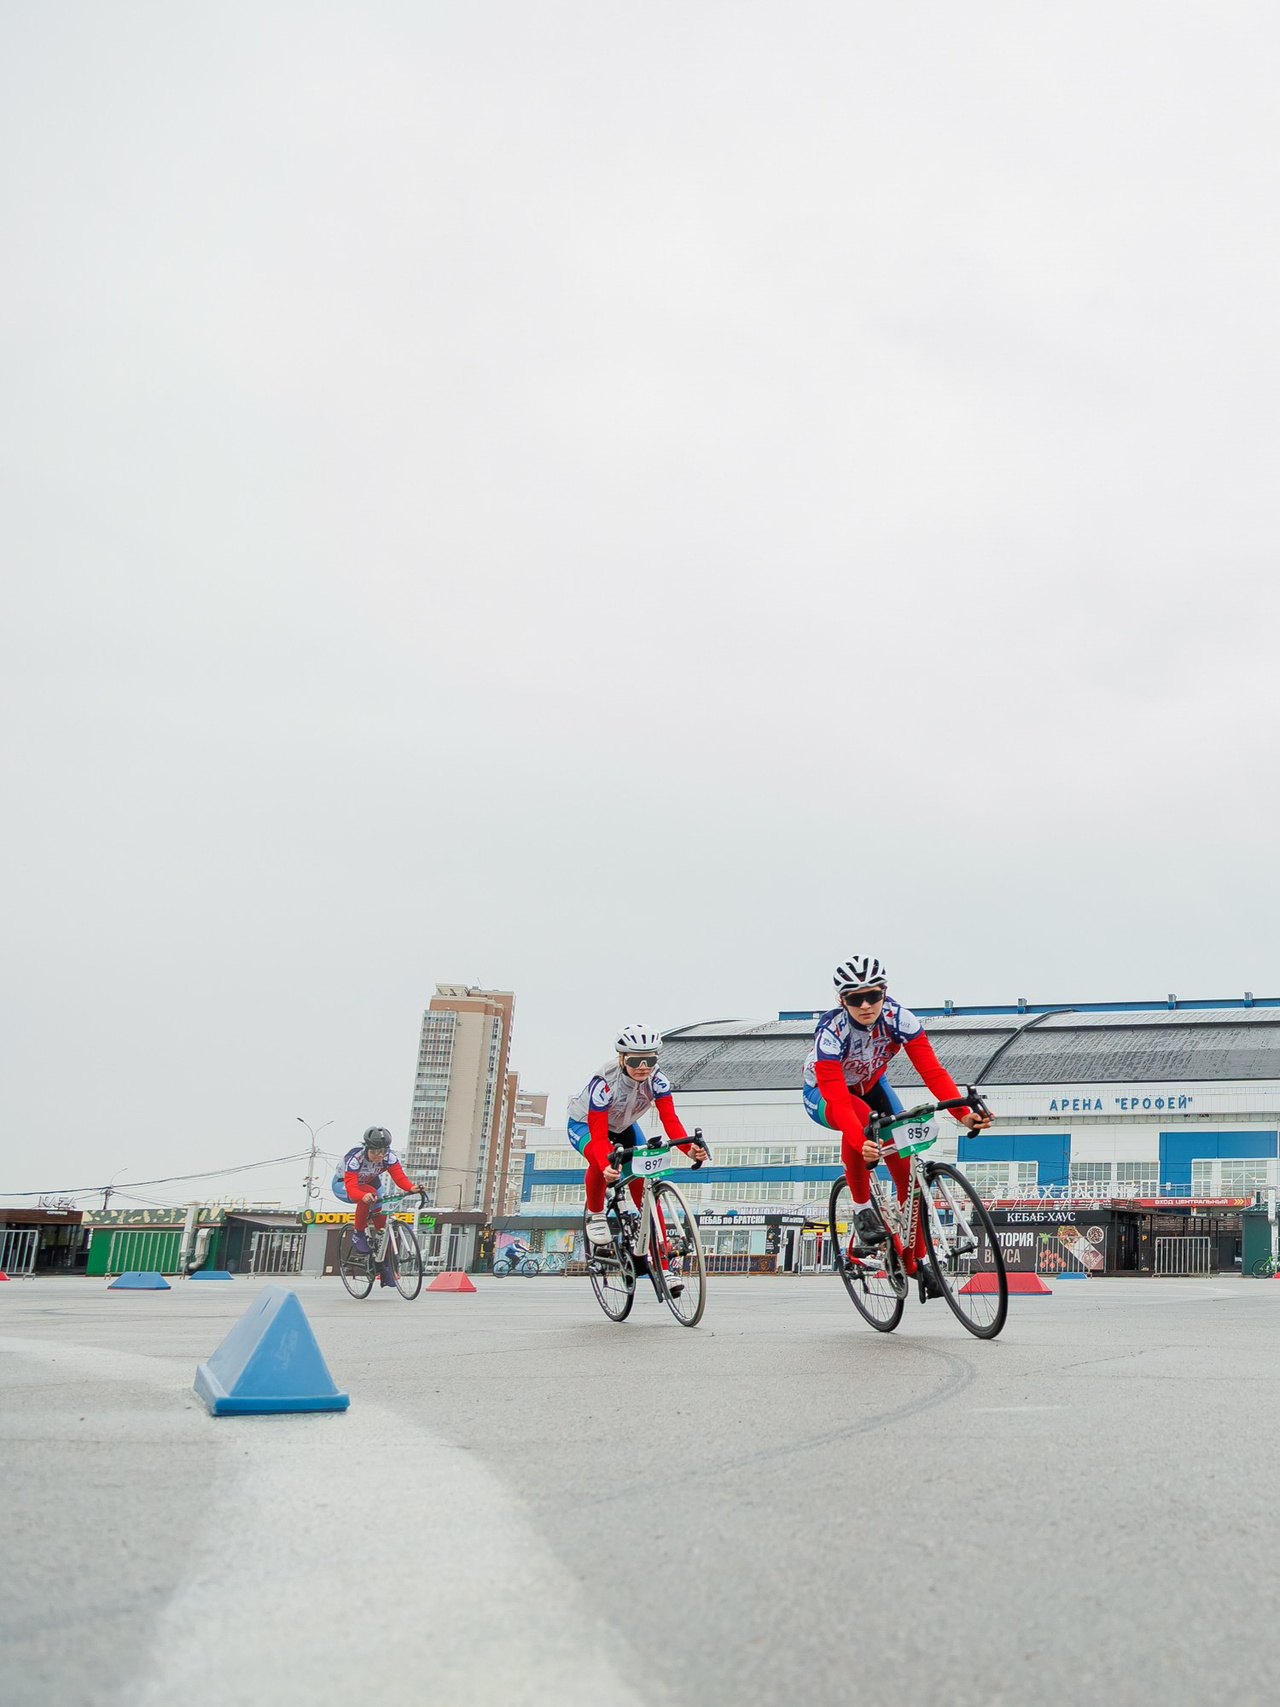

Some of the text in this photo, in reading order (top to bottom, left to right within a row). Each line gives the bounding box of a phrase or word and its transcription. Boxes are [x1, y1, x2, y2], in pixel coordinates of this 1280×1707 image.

[1049, 1095, 1193, 1111] АРЕНА "ЕРОФЕЙ"
[907, 1126, 931, 1140] 859
[644, 1158, 663, 1171] 897
[699, 1215, 765, 1225] КЕБАБ по БРАТСКИ
[1006, 1212, 1076, 1222] КЕБАБ-ХАУС
[908, 1199, 920, 1249] COLNAGO
